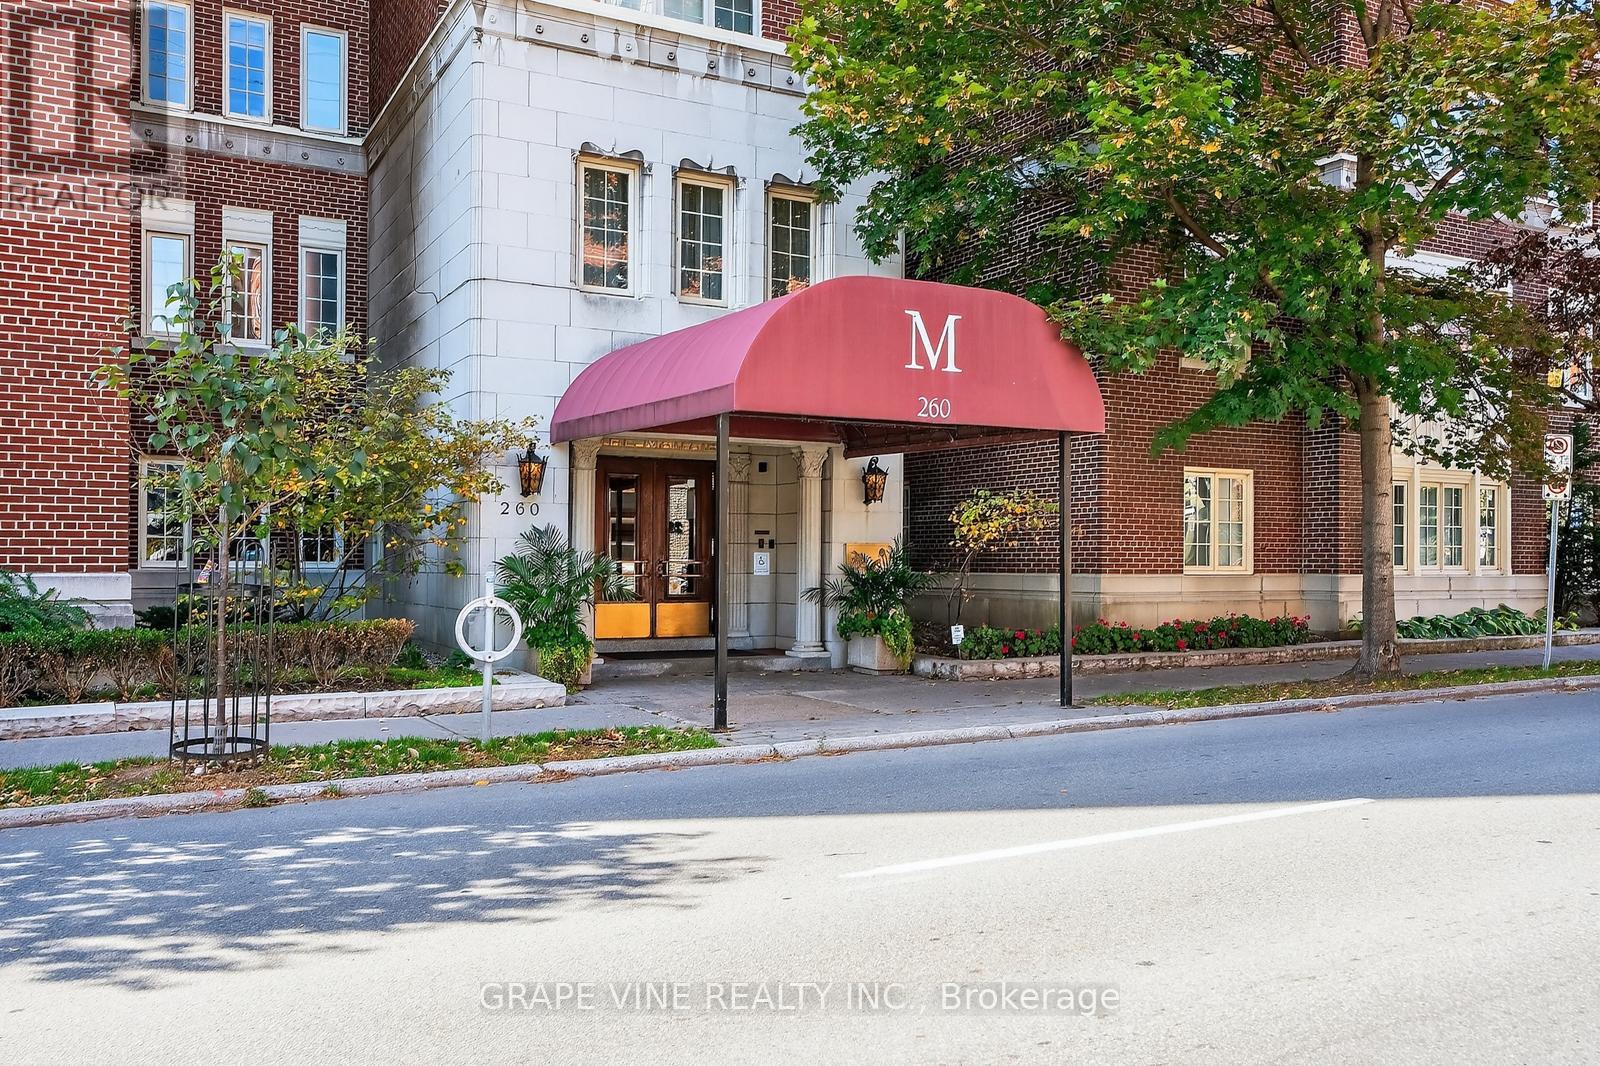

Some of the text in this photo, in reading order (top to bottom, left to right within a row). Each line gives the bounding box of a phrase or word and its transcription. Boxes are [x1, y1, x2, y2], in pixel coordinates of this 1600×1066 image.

[904, 309, 963, 373] M
[917, 396, 951, 419] 260
[500, 501, 540, 516] 260
